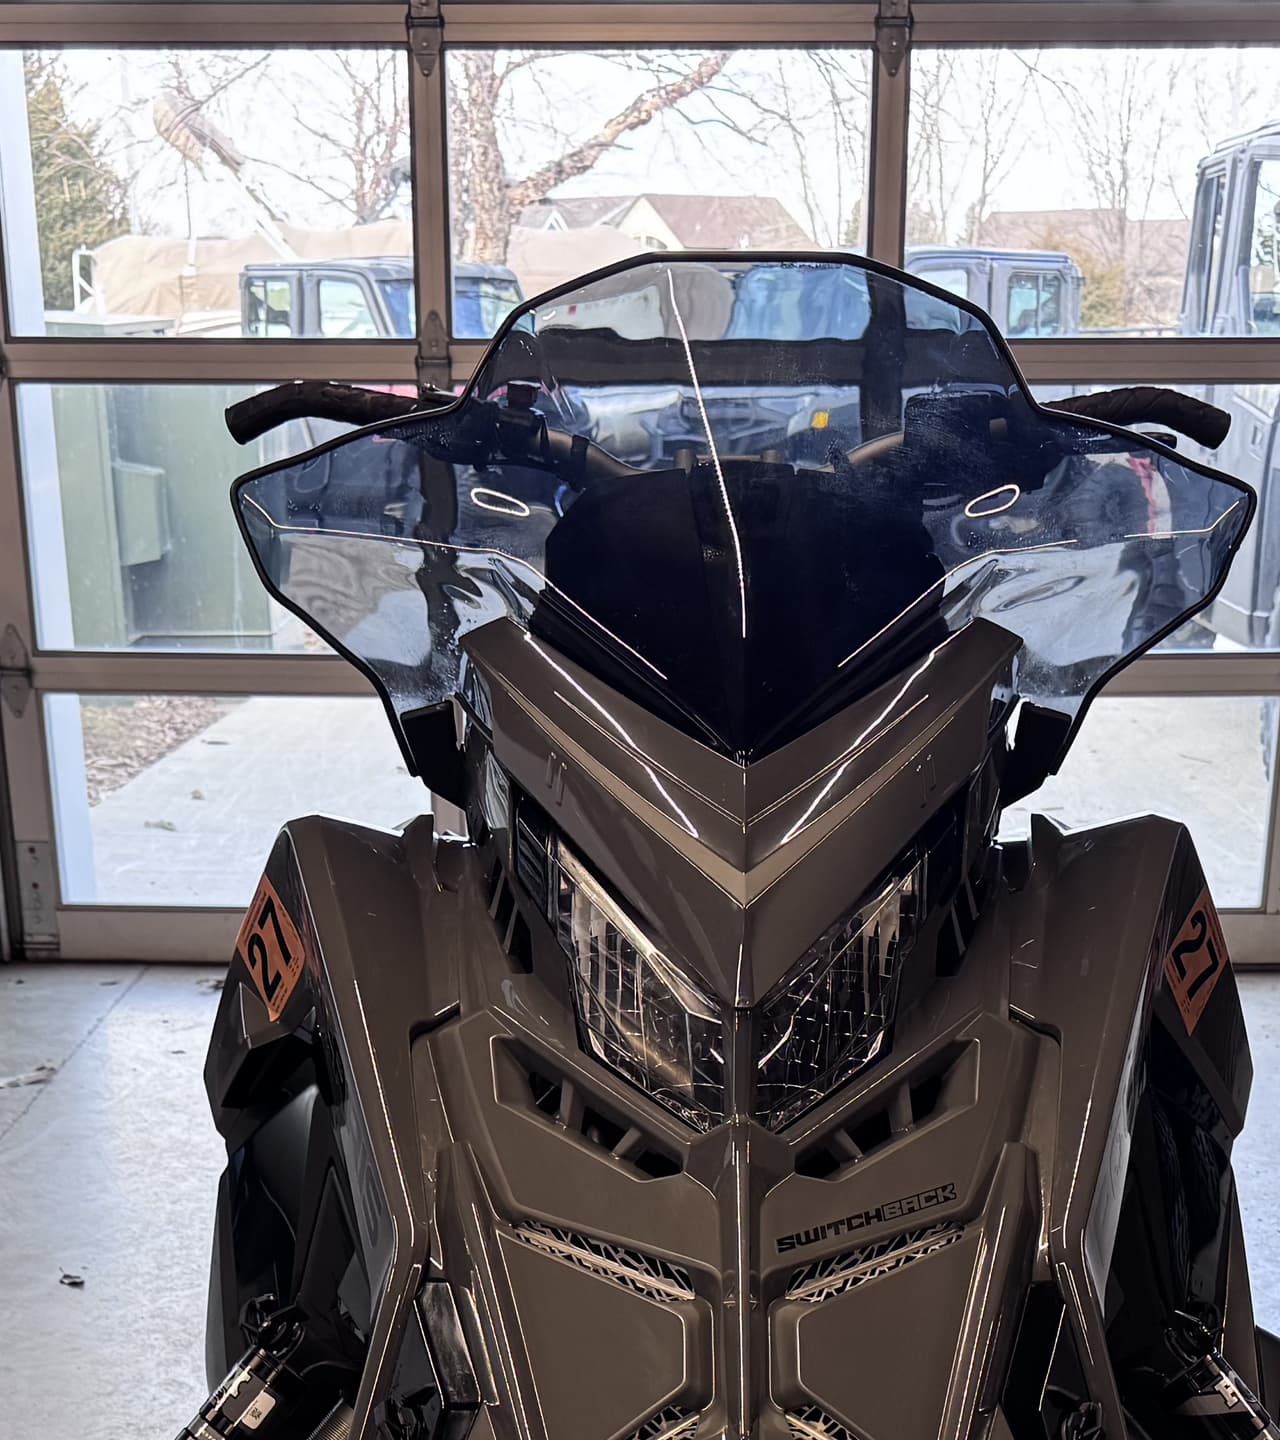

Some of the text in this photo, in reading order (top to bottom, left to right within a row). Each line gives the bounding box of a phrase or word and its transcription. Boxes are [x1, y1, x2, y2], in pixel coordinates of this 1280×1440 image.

[246, 895, 293, 1003] 27
[1171, 909, 1220, 1001] 27
[775, 1182, 958, 1254] SWITCHBACK
